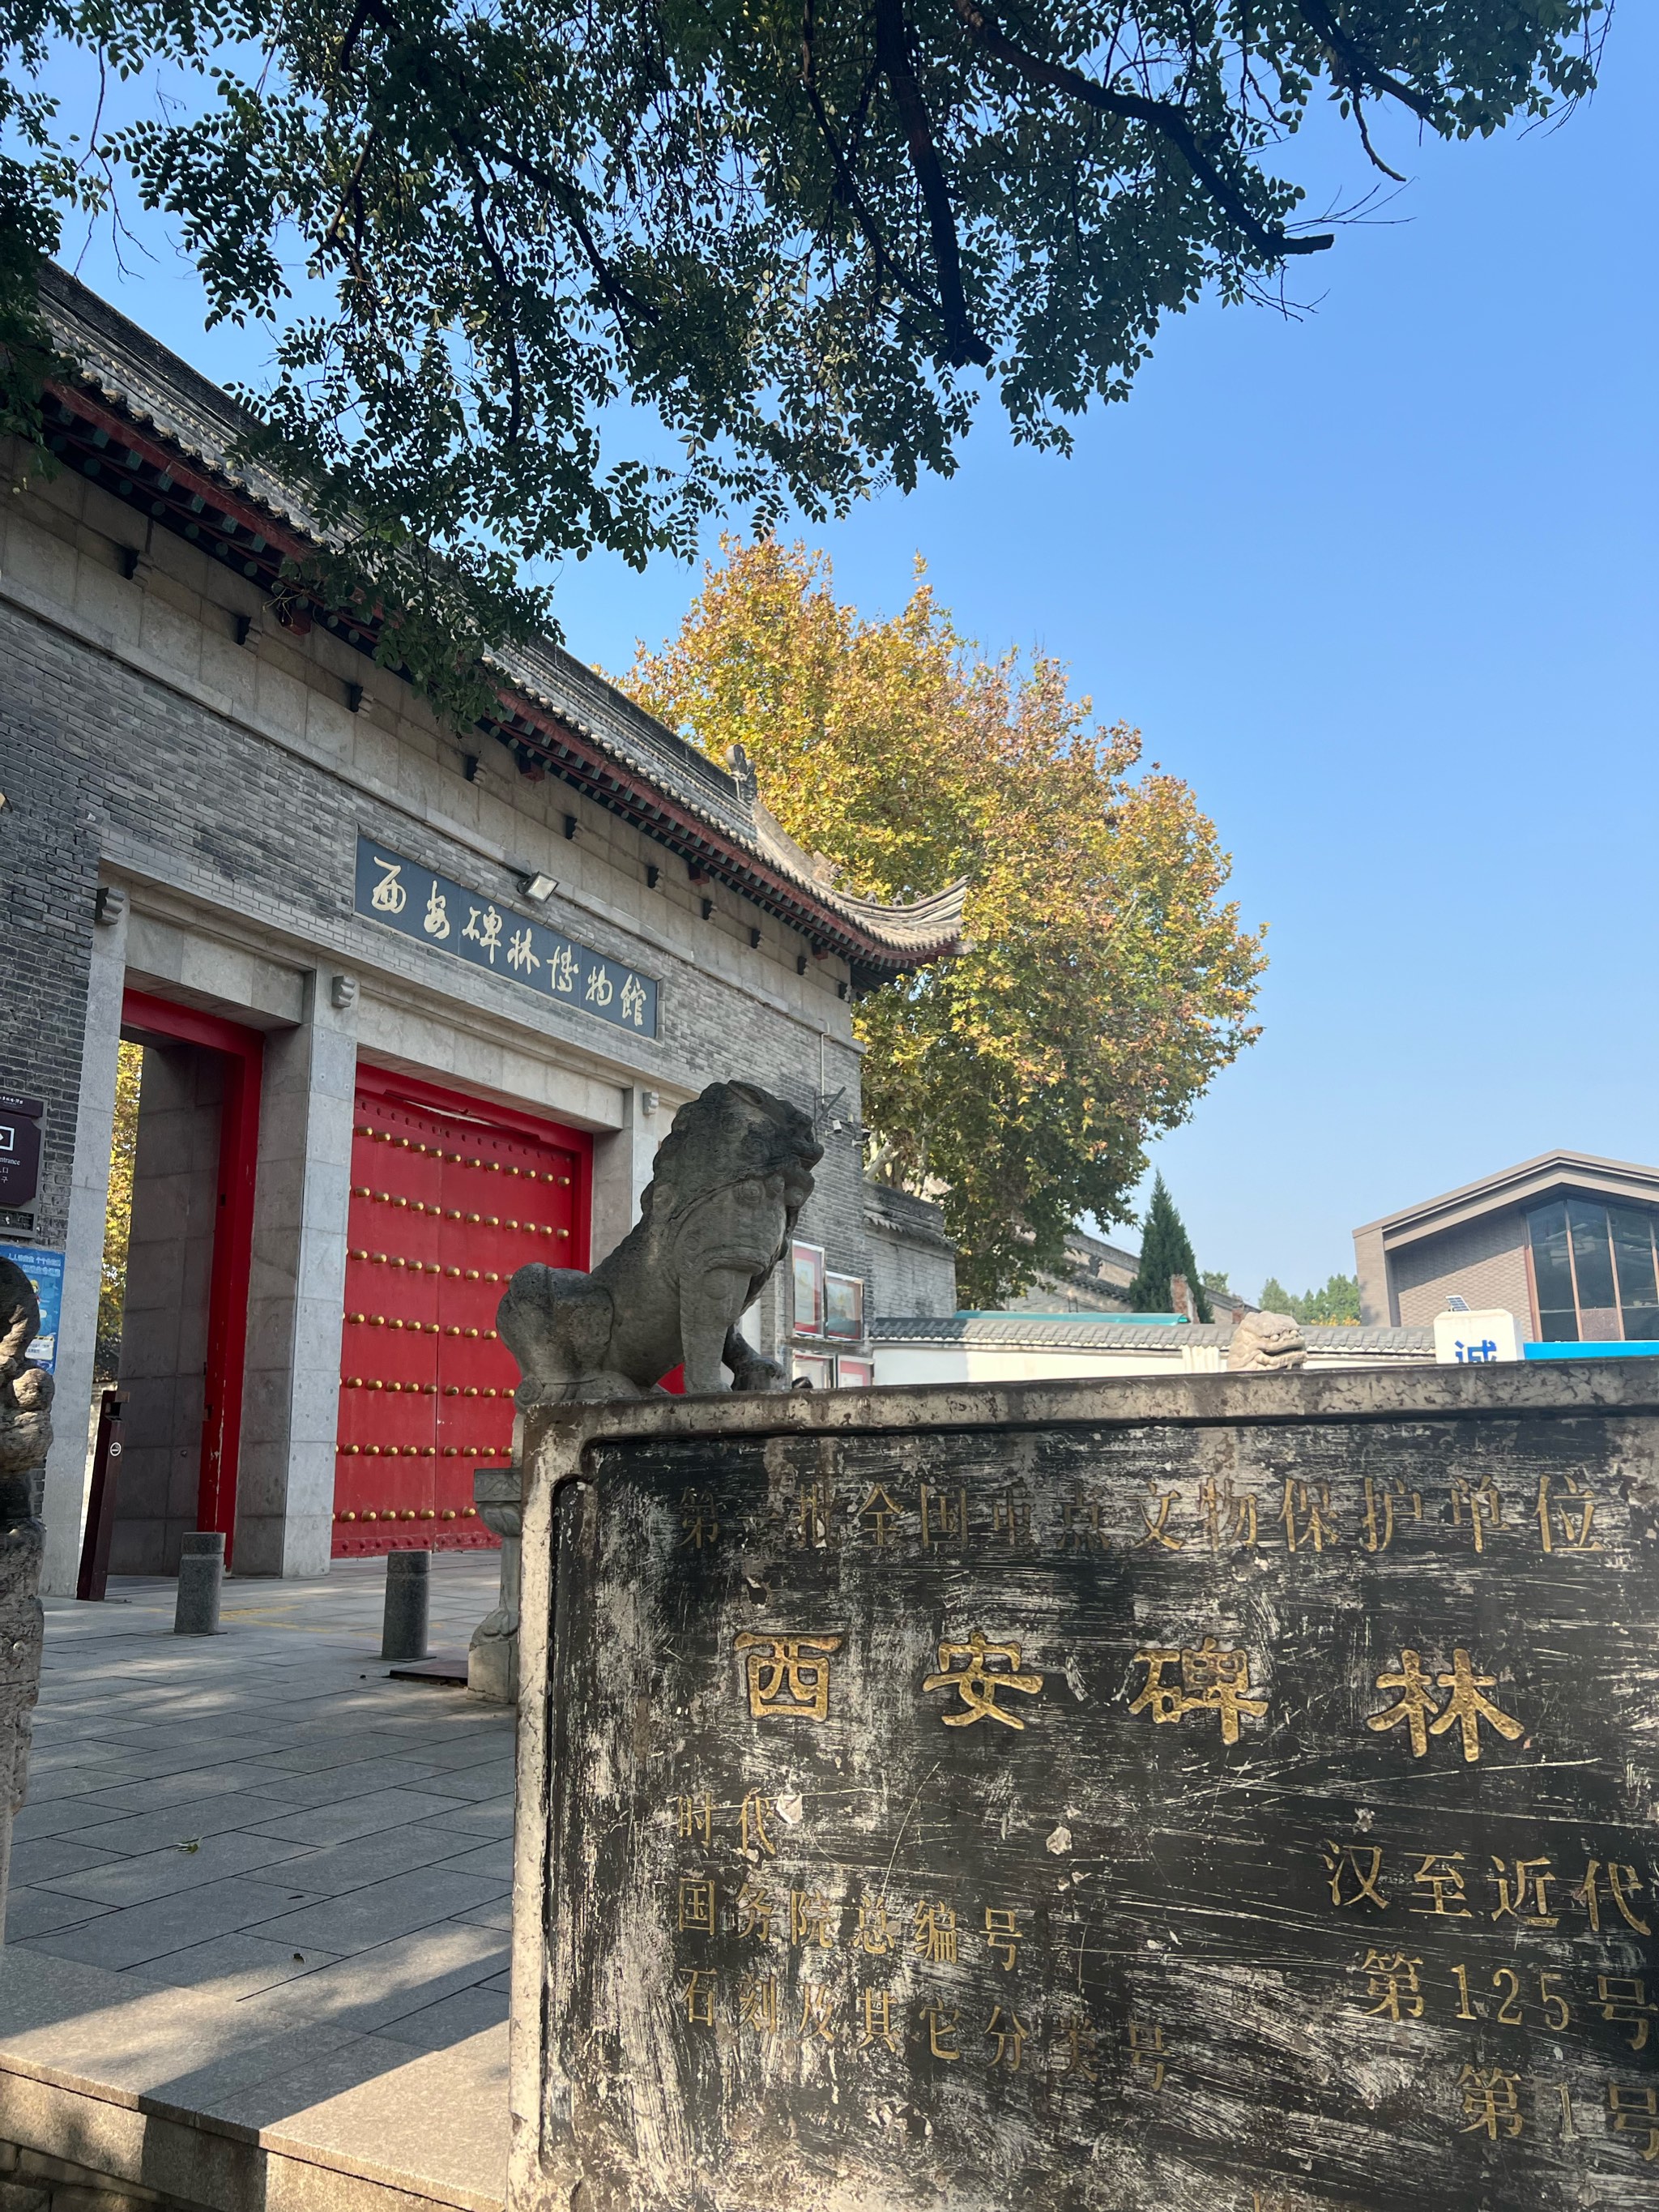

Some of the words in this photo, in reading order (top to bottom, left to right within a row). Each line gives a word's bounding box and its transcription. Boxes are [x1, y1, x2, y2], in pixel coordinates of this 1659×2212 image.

[0, 1157, 20, 1166] ntrance
[679, 1475, 1606, 1552] 第一批全国重点文物保护单位
[733, 1630, 1526, 1762] 西安碑林
[678, 1787, 777, 1856] 时代
[678, 1877, 1023, 1971] 国务院总编号
[1323, 1838, 1652, 1936] 汉至近代
[680, 1966, 1171, 2092] 石刻及其它分类号
[1360, 1948, 1658, 2051] 第125号
[1457, 2064, 1659, 2161] 第1号
